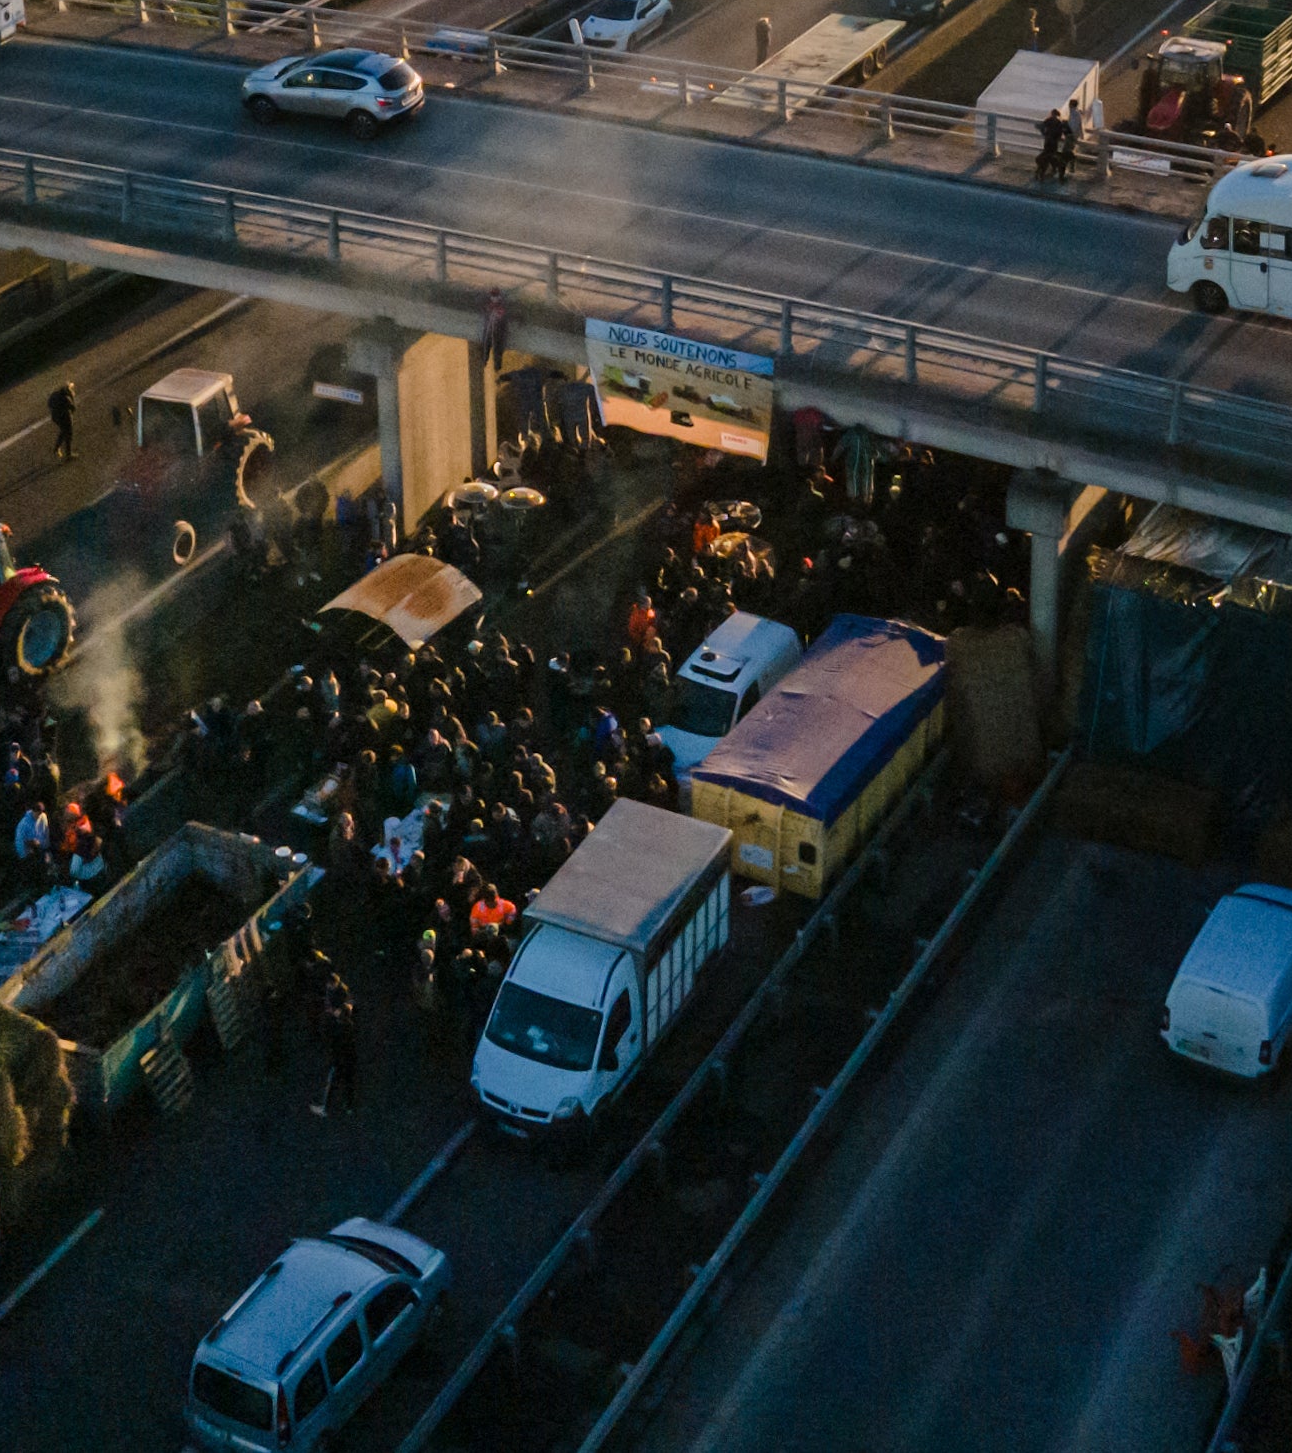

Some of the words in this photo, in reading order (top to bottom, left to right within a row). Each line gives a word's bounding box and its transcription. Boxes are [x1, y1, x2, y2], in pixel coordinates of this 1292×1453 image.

[609, 327, 647, 345] NOUS
[654, 334, 737, 368] SOUTENONS
[609, 346, 626, 358] LE
[635, 350, 680, 372] MONDE
[685, 363, 753, 390] AGRICOLE
